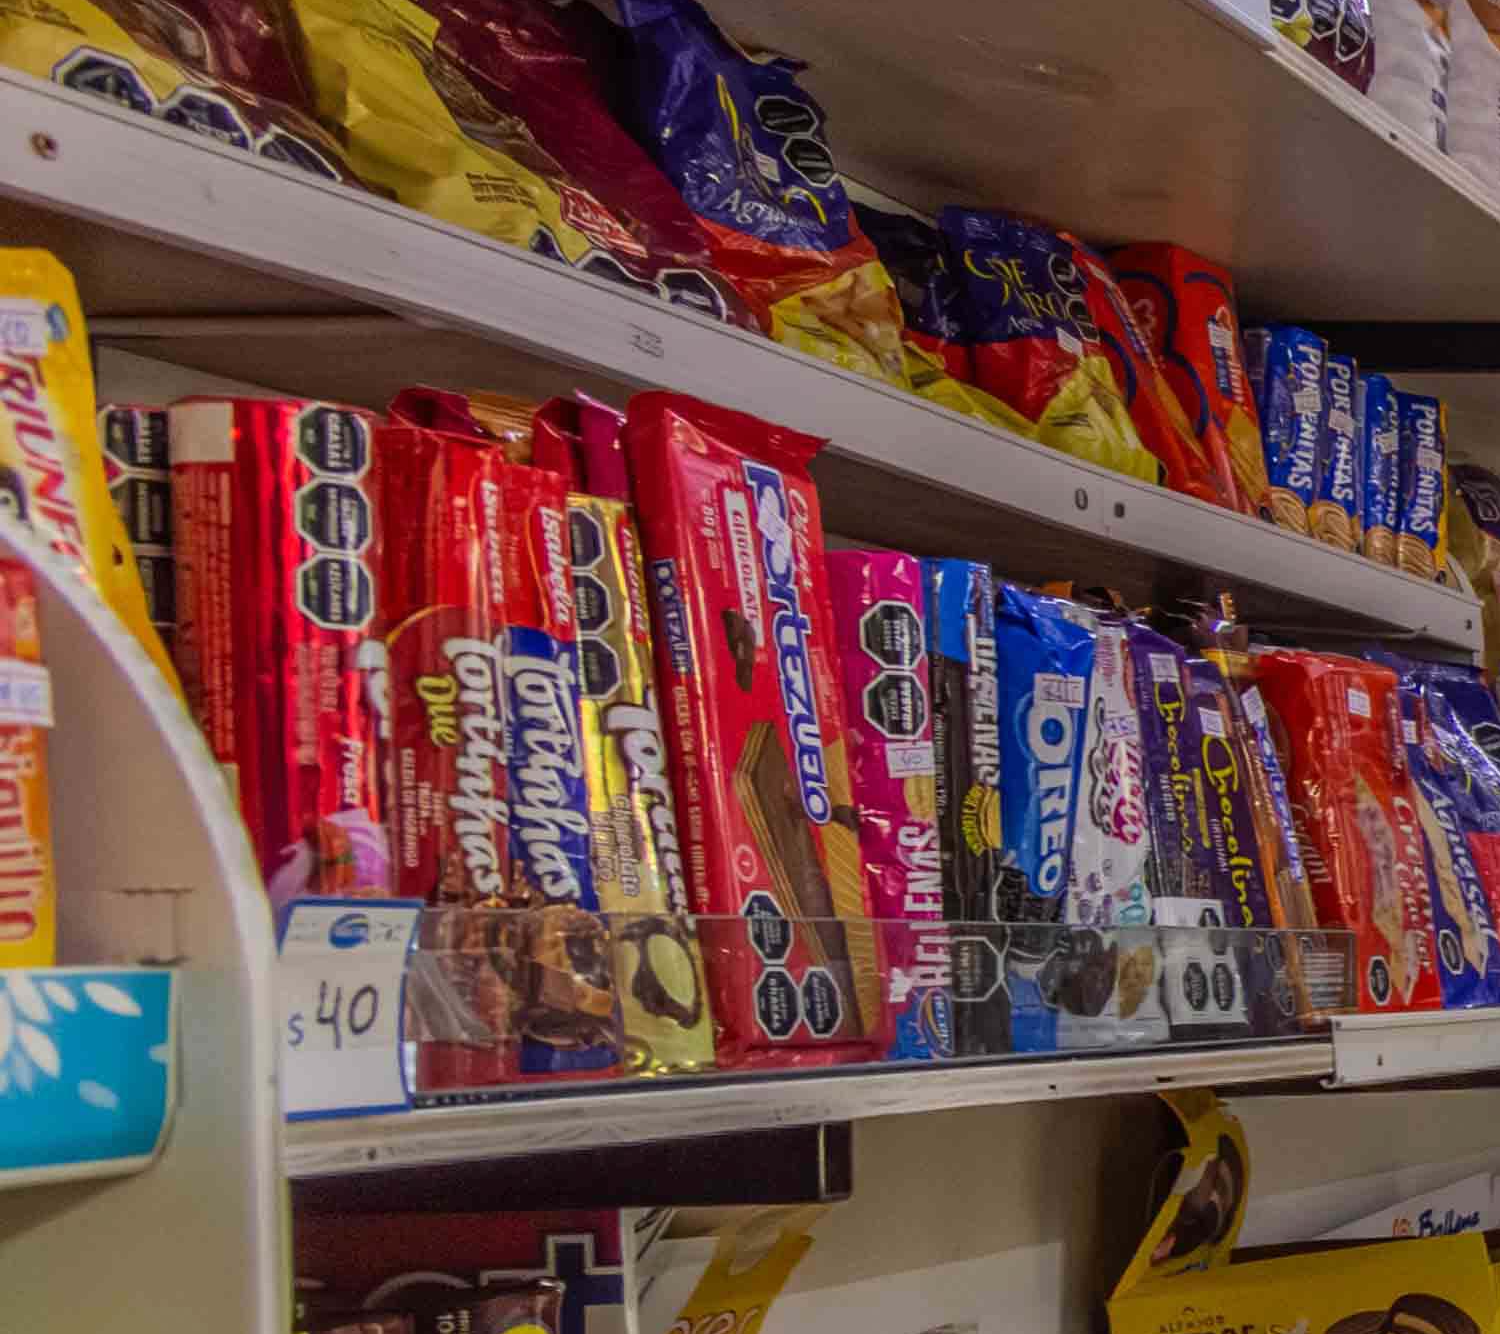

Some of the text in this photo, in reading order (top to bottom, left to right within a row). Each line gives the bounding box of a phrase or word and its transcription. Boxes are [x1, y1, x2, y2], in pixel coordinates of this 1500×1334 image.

[503, 651, 589, 901] Tortinhas
[1027, 701, 1076, 897] OREO
[1202, 734, 1257, 935] Chocolina
[314, 981, 381, 1050] 40
